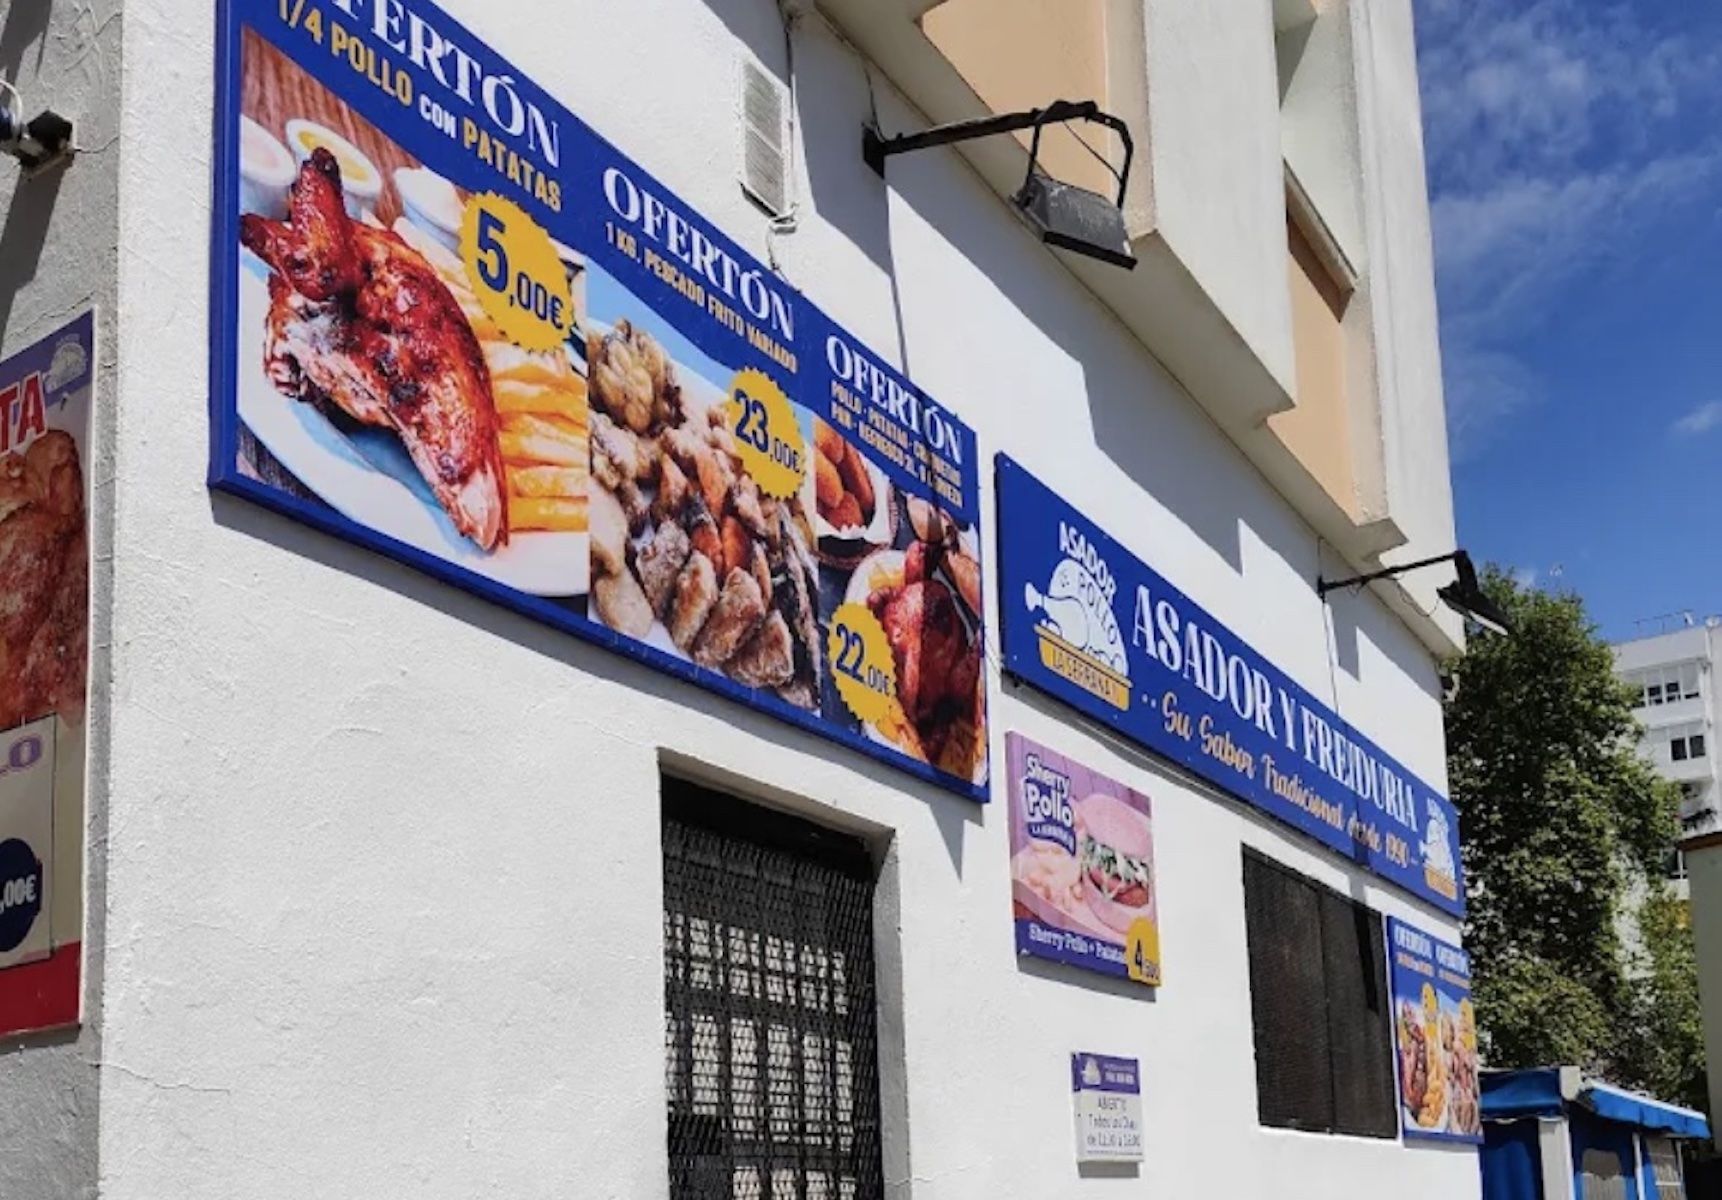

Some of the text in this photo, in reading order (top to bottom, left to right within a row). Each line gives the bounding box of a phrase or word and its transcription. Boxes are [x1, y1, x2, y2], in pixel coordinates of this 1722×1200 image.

[331, 21, 413, 106] POLLO
[463, 116, 562, 212] PATATAS
[477, 208, 565, 330] 5,00€
[603, 167, 795, 342] OFERTÓN
[643, 247, 705, 308] PESCADO
[707, 293, 745, 337] FRITO
[746, 321, 797, 375] VARIADO
[735, 388, 801, 473] 23,00€
[826, 335, 962, 465] OFERTÓN
[1059, 520, 1117, 606] ASADOR
[1079, 571, 1117, 645] POLLO
[1133, 584, 1419, 833] ASADOR Y FREIDURIA
[1026, 754, 1069, 800] Sherry
[1026, 782, 1073, 828] Pollo
[1200, 714, 1256, 780] Sabor
[1261, 752, 1345, 832] Tradicional
